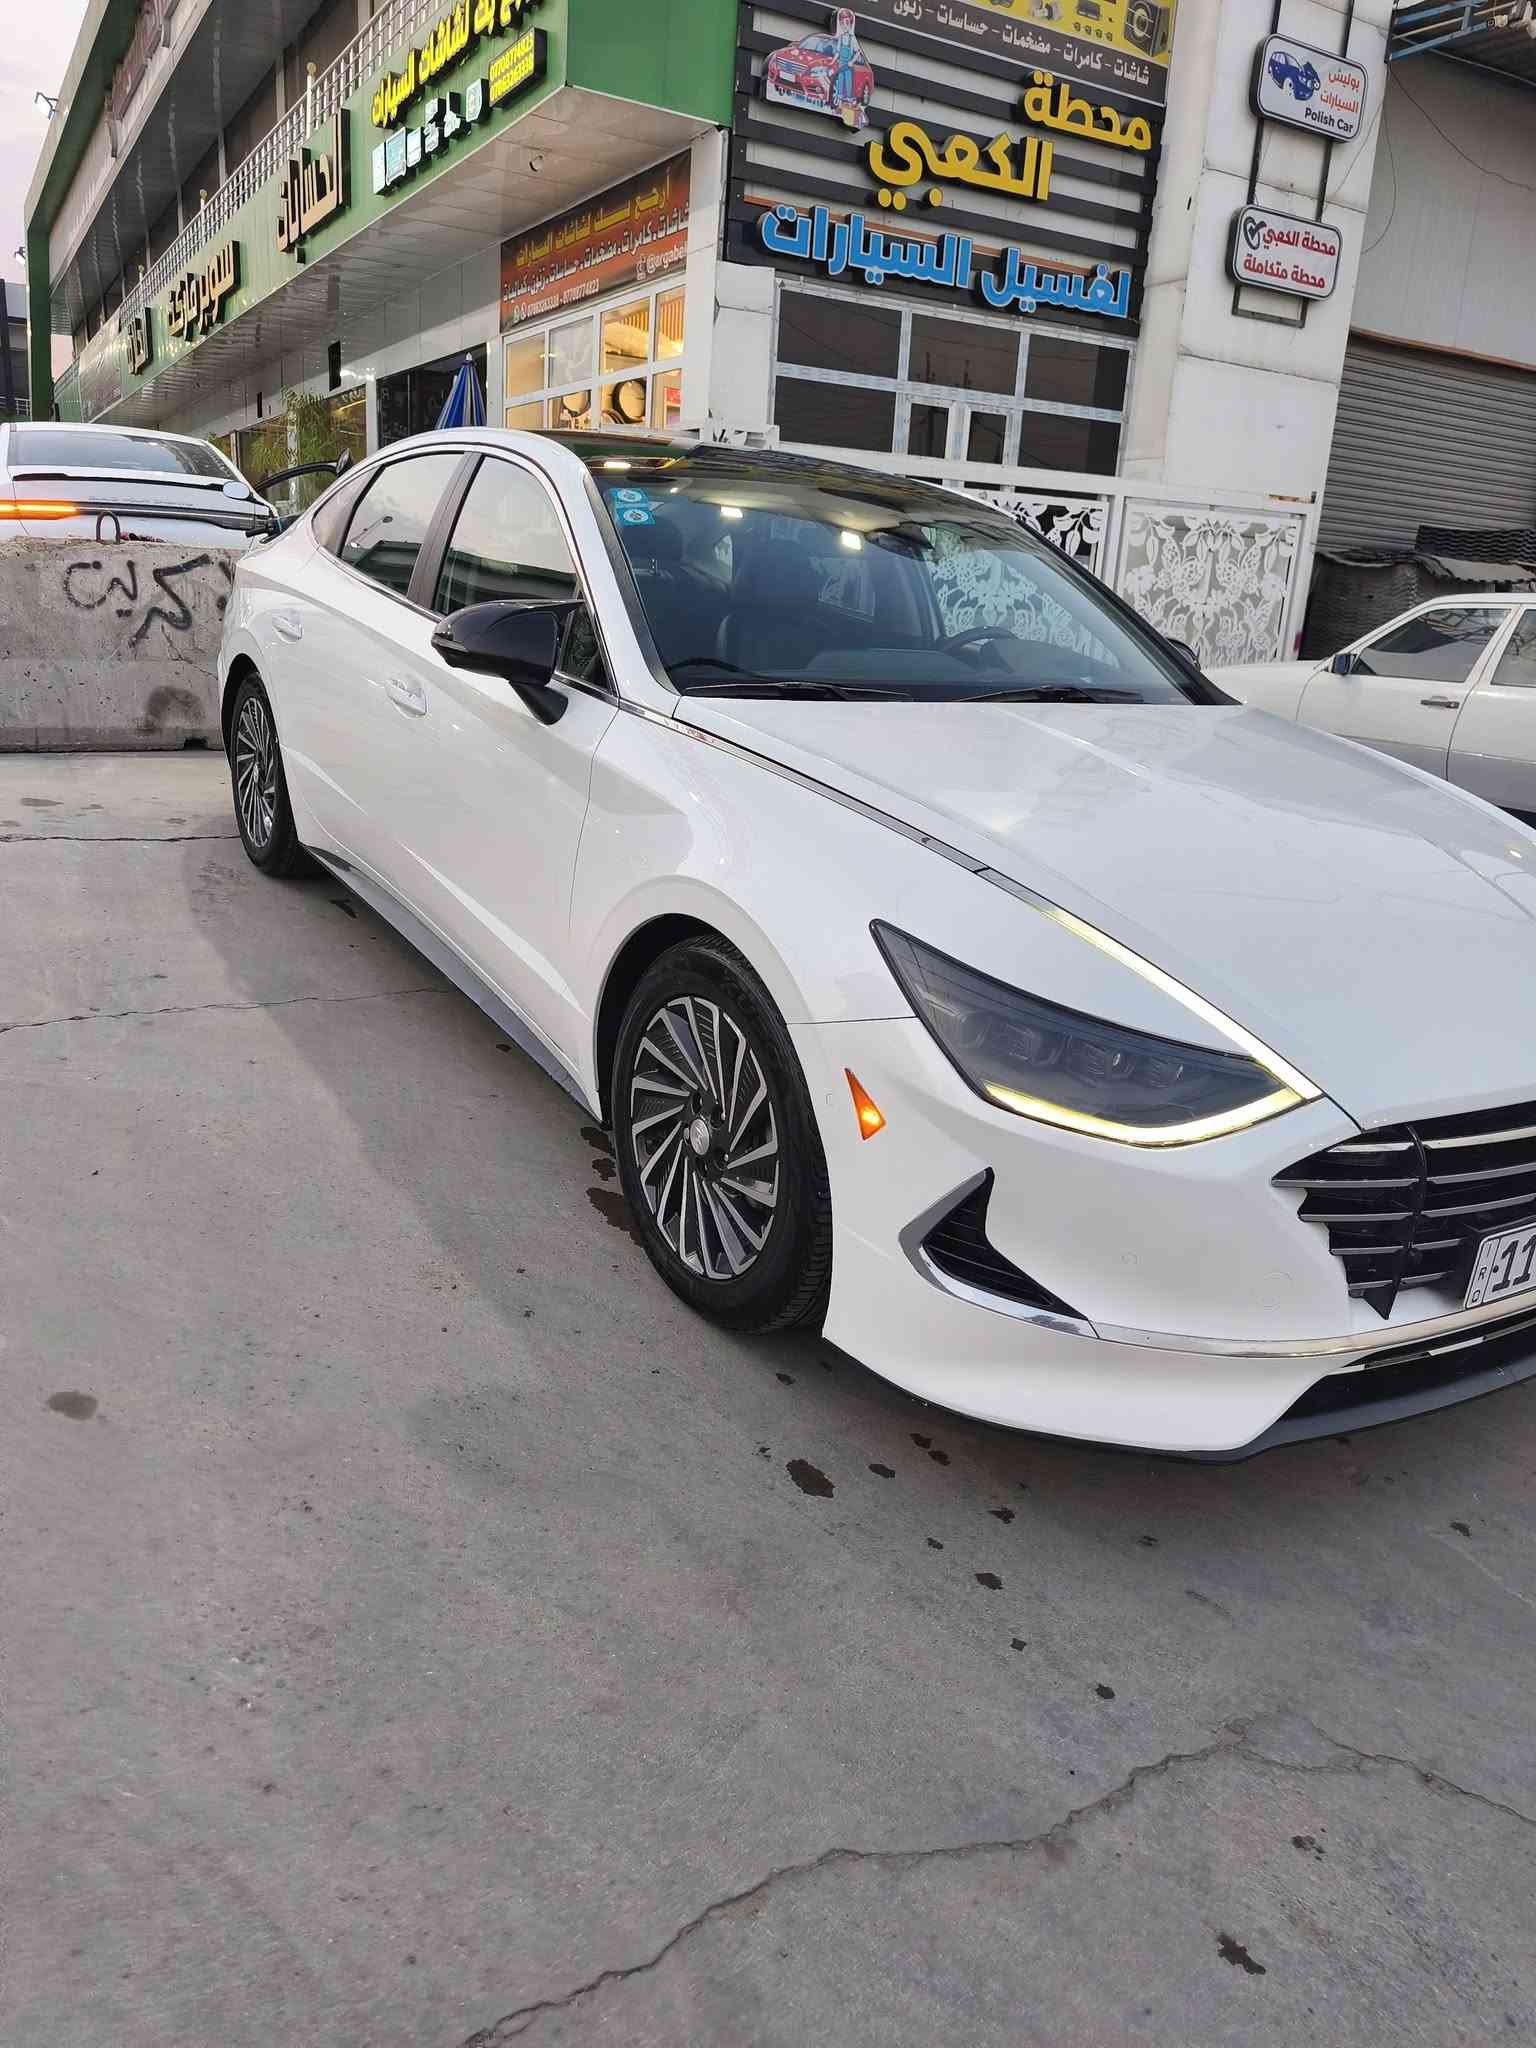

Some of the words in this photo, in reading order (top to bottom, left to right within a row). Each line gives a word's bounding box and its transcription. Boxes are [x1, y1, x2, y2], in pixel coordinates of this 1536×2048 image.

[937, 4, 988, 36] حساسات
[1002, 24, 1051, 54] مضخمات
[1063, 43, 1103, 70] كامرات
[1113, 58, 1150, 86] شاشات
[1024, 71, 1152, 151] محطة
[1320, 90, 1359, 113] السيارات
[1305, 107, 1335, 127] Polish
[1337, 118, 1353, 133] Car
[869, 121, 1055, 211] الكعبي
[761, 204, 972, 288] السيارات
[1263, 228, 1300, 250] الكعبي
[1302, 231, 1336, 256] محطة
[1244, 253, 1288, 279] متكاملة
[1291, 264, 1325, 288] محطة
